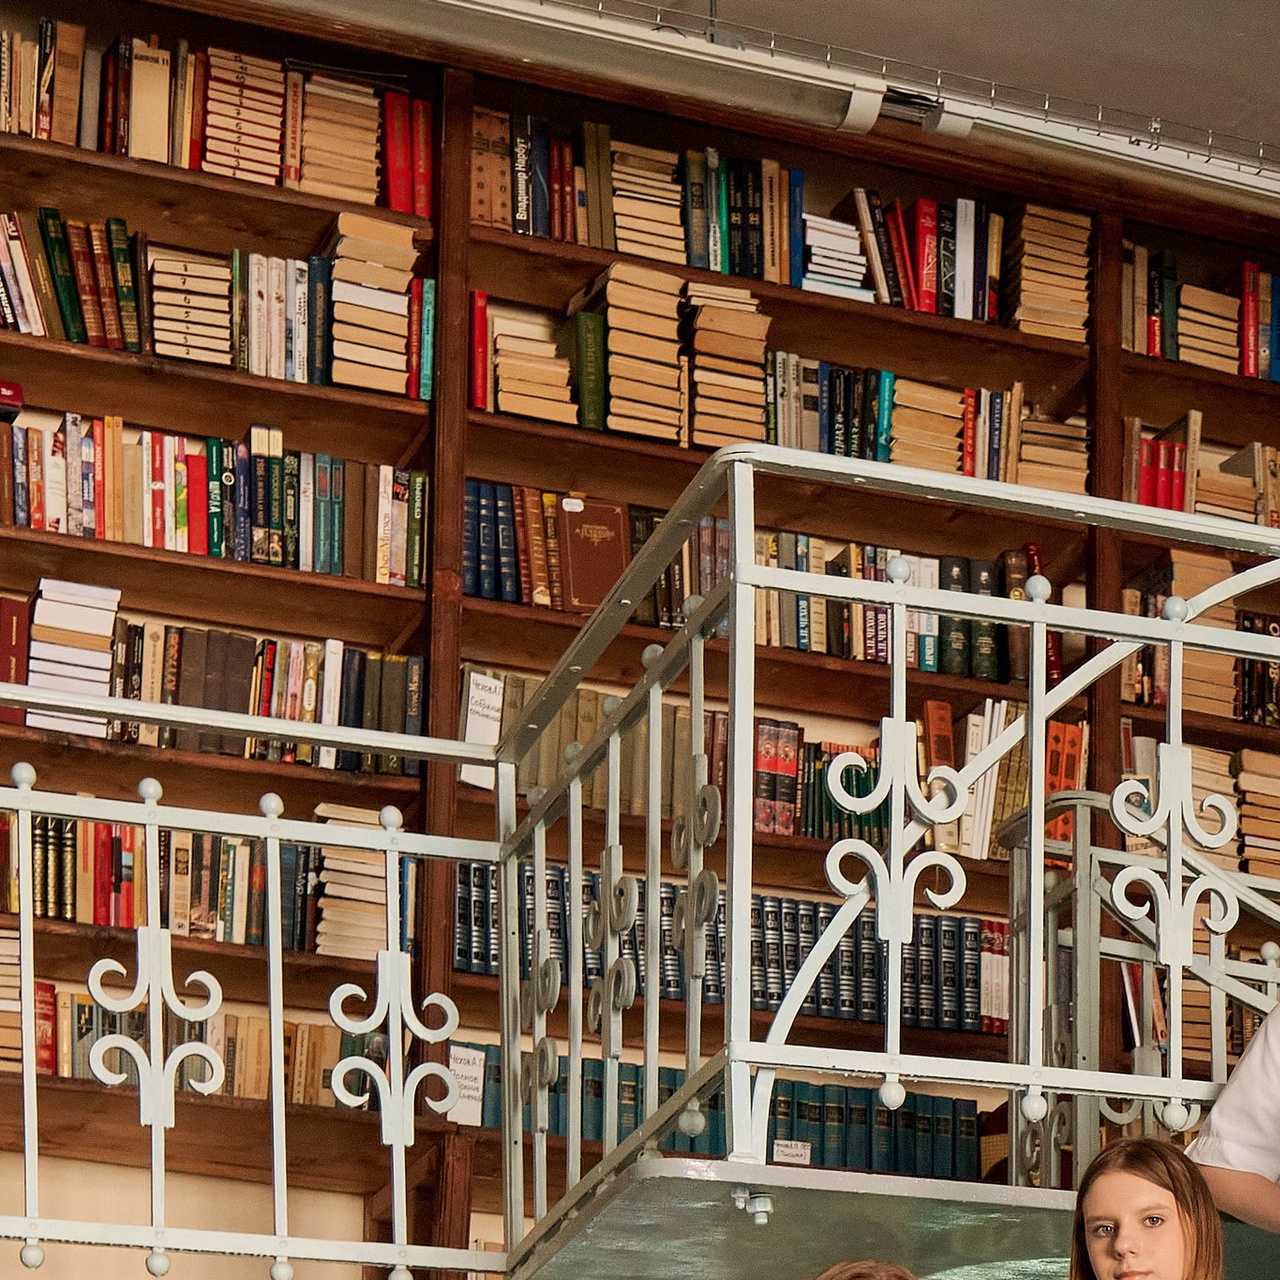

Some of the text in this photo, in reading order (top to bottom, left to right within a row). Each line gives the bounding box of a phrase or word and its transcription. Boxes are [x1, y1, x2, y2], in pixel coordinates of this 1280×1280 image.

[513, 137, 527, 171] Нарбут
[515, 172, 528, 220] Владимир
[414, 477, 423, 519] СУВОРОВ
[799, 599, 809, 646] А.П.ЧЕХОВ
[866, 610, 876, 654] А.П.ЧЕХОВ
[877, 613, 887, 657] А.П.ЧЕХОВ
[164, 632, 180, 690] КУТУЗОВ
